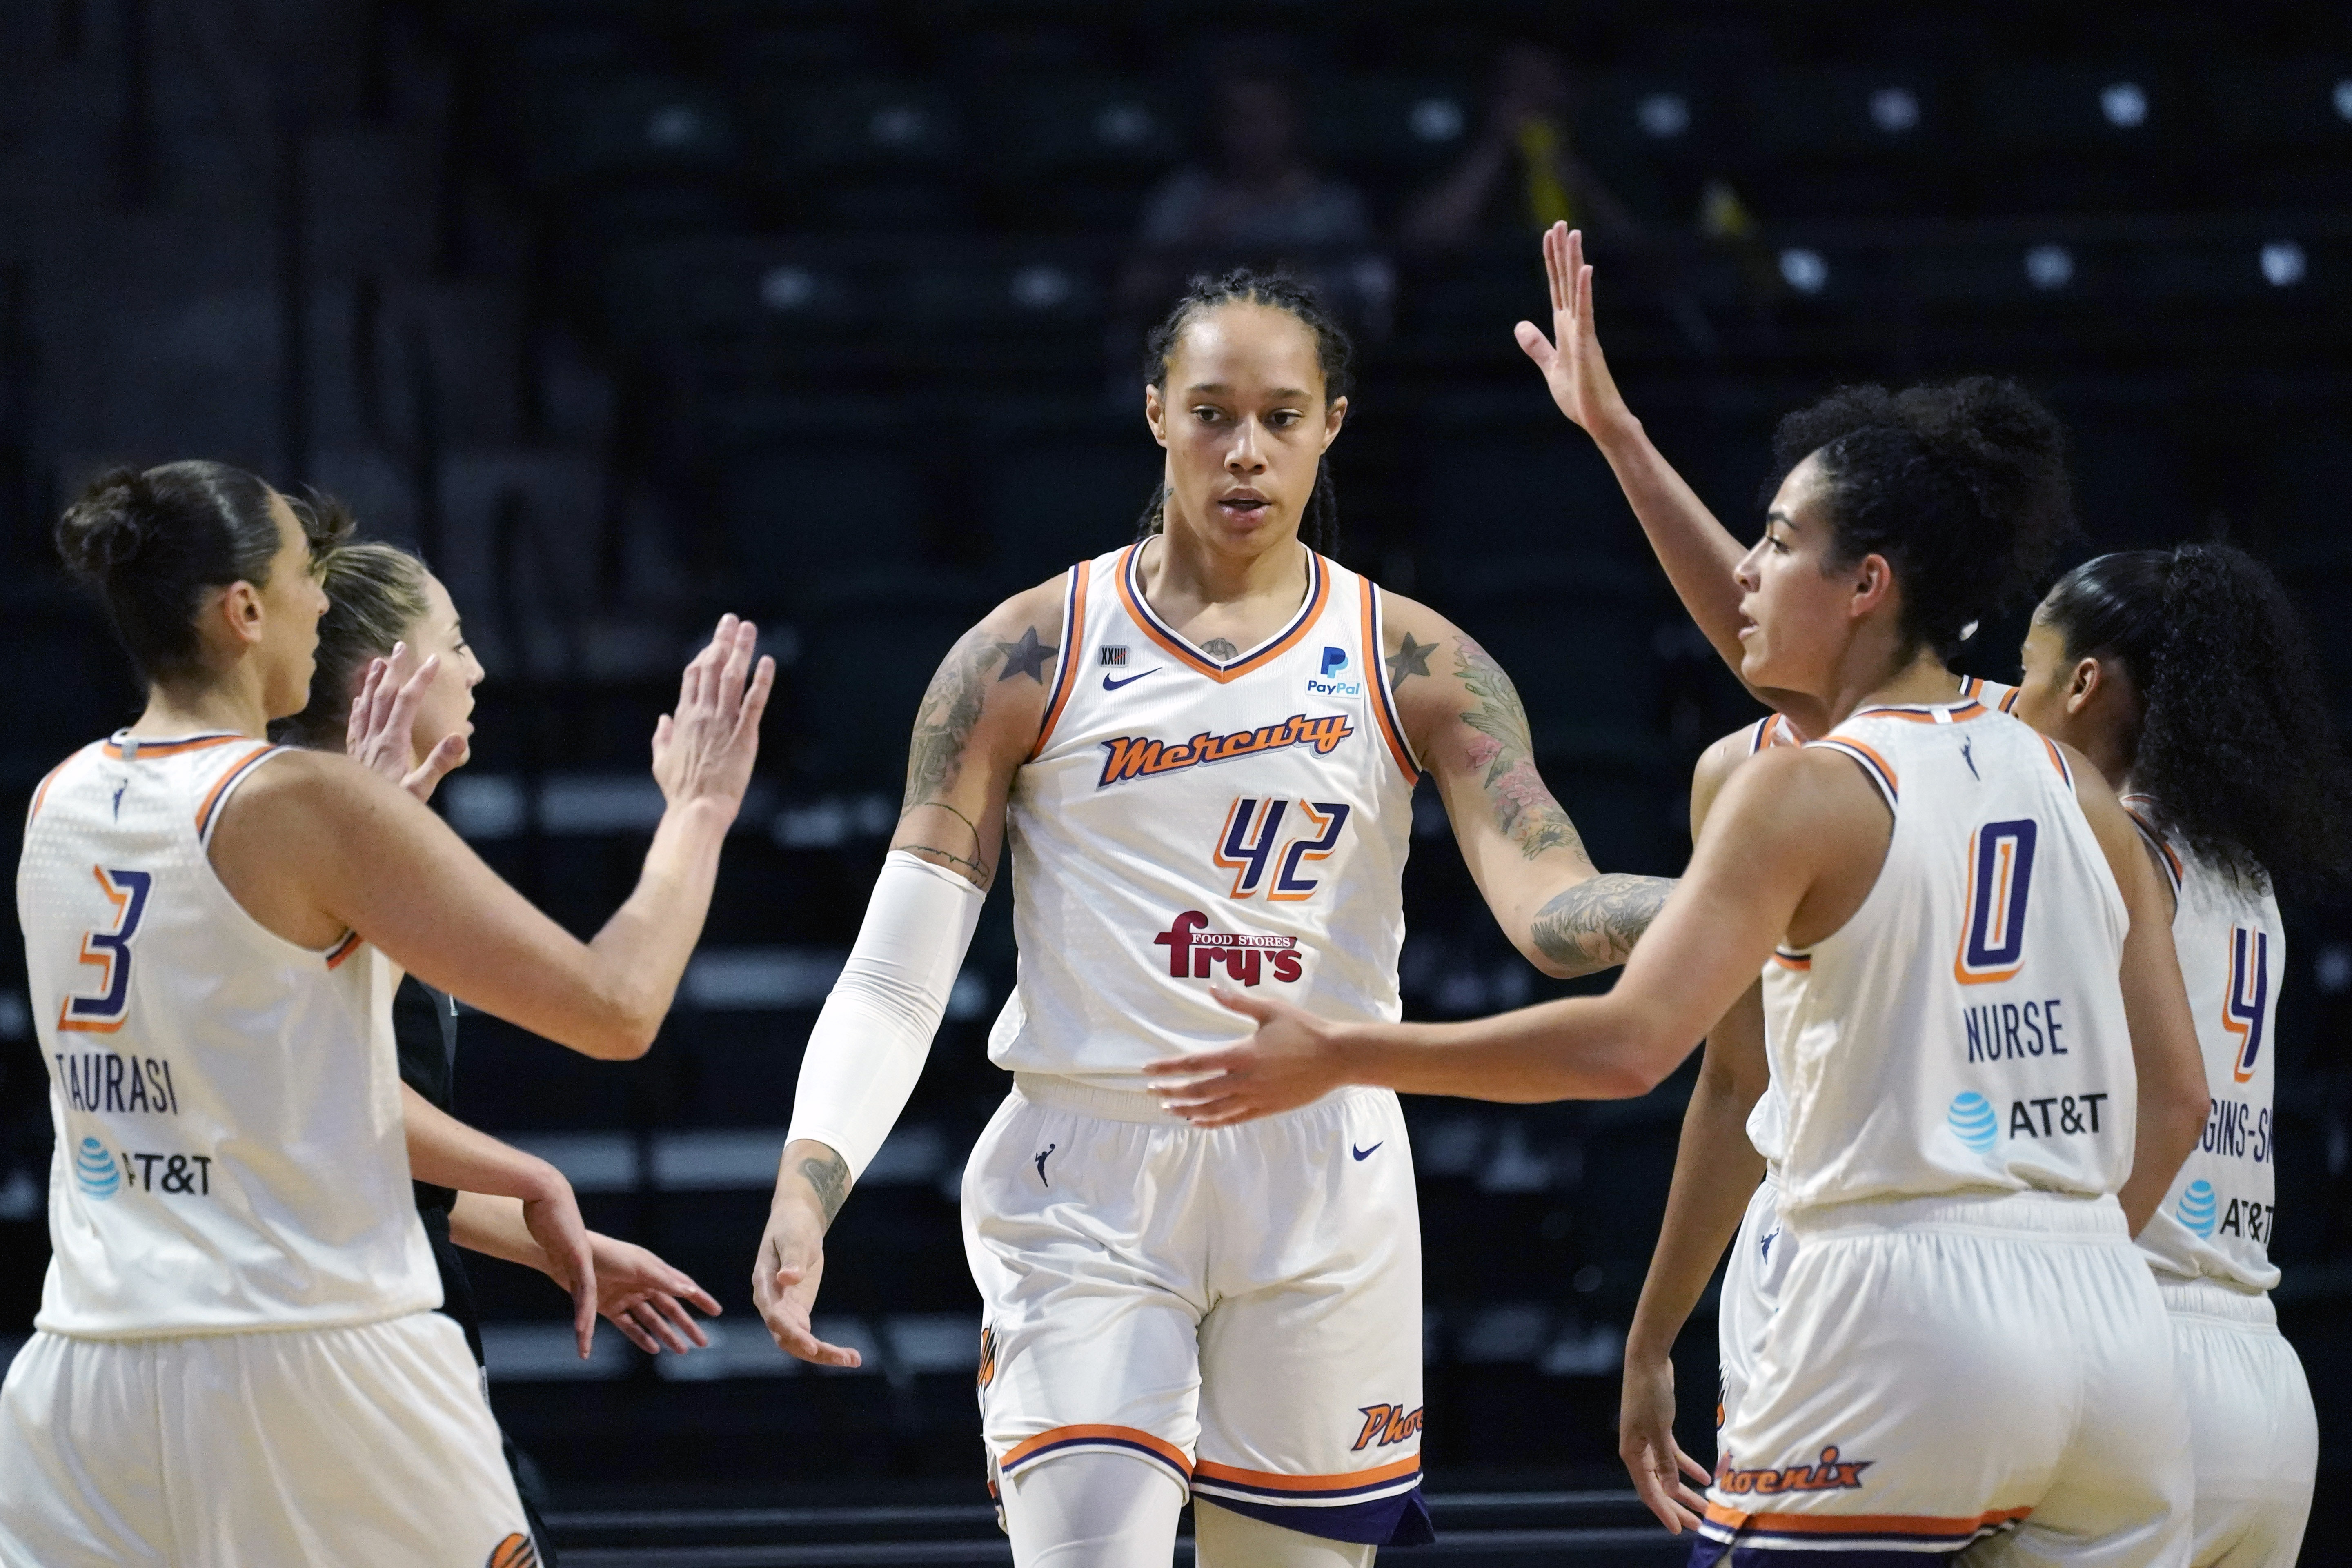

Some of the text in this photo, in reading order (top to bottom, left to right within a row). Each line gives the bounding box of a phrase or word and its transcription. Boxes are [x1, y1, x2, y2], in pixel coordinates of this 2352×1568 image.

[1308, 680, 1360, 695] PayPal
[1098, 713, 1354, 788] Mercury
[1213, 796, 1351, 901] 42
[1954, 818, 2037, 985] 0
[58, 863, 152, 1032] 3
[1153, 910, 1302, 987] fry's
[1191, 933, 1291, 947] FOOD STORES
[1963, 1000, 2068, 1063] NURSE
[2222, 923, 2267, 1083] 4
[55, 1054, 178, 1114] TAURASI
[2009, 1093, 2108, 1140] AT&T
[2219, 1198, 2274, 1244] AT&T
[1715, 1444, 1876, 1496] hoenix
